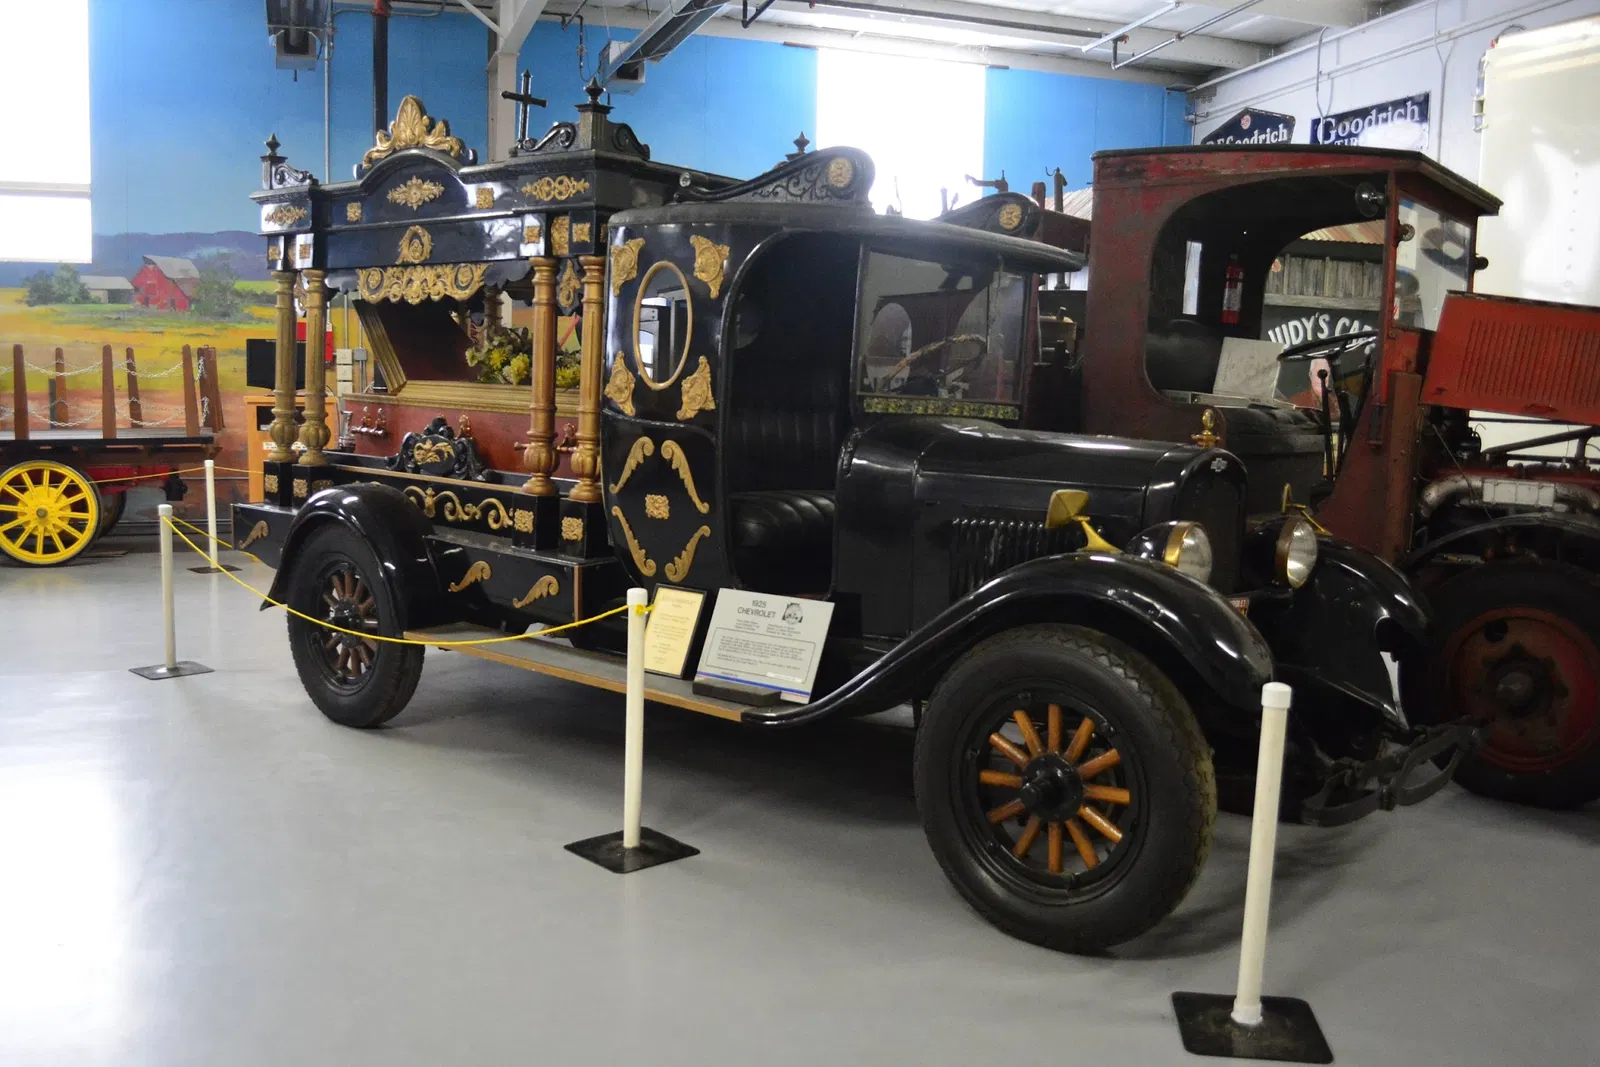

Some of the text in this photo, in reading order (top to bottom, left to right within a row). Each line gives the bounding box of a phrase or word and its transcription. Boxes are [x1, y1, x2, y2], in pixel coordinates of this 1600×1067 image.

[1316, 101, 1420, 145] Goodrich
[752, 599, 768, 608] 1925
[737, 606, 777, 618] CHEVROLET
